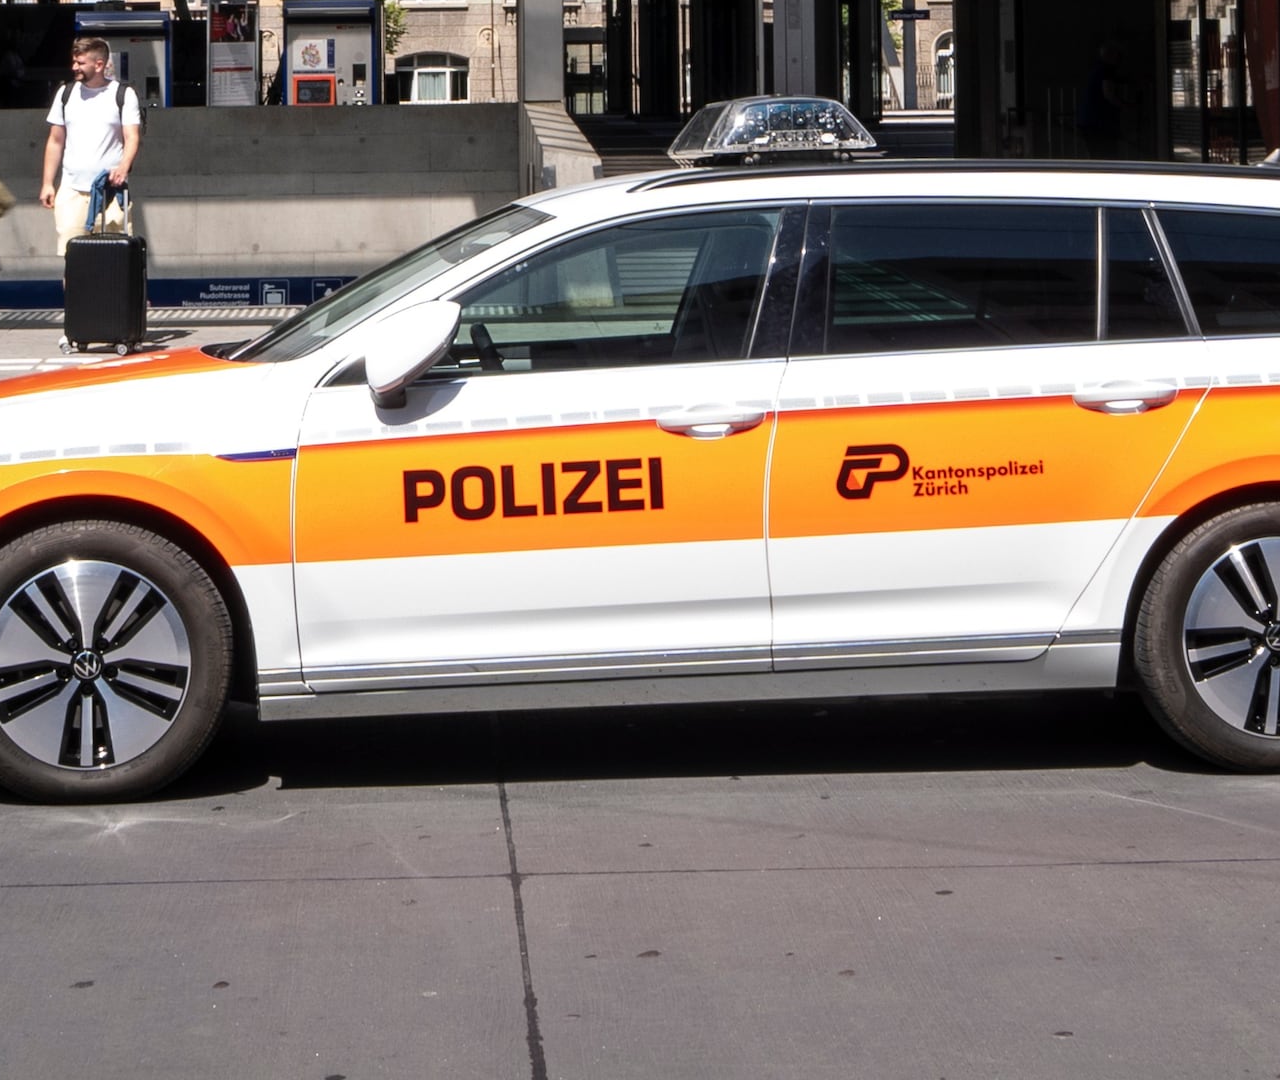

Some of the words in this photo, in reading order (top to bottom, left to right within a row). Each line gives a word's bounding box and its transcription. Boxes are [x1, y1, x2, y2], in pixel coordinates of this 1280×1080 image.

[199, 291, 250, 300] Rudolfstrasse
[208, 283, 250, 292] Sulzerareal
[912, 460, 1044, 481] Kantonspolizei
[403, 457, 664, 524] POLIZEI
[913, 480, 968, 497] Zürich
